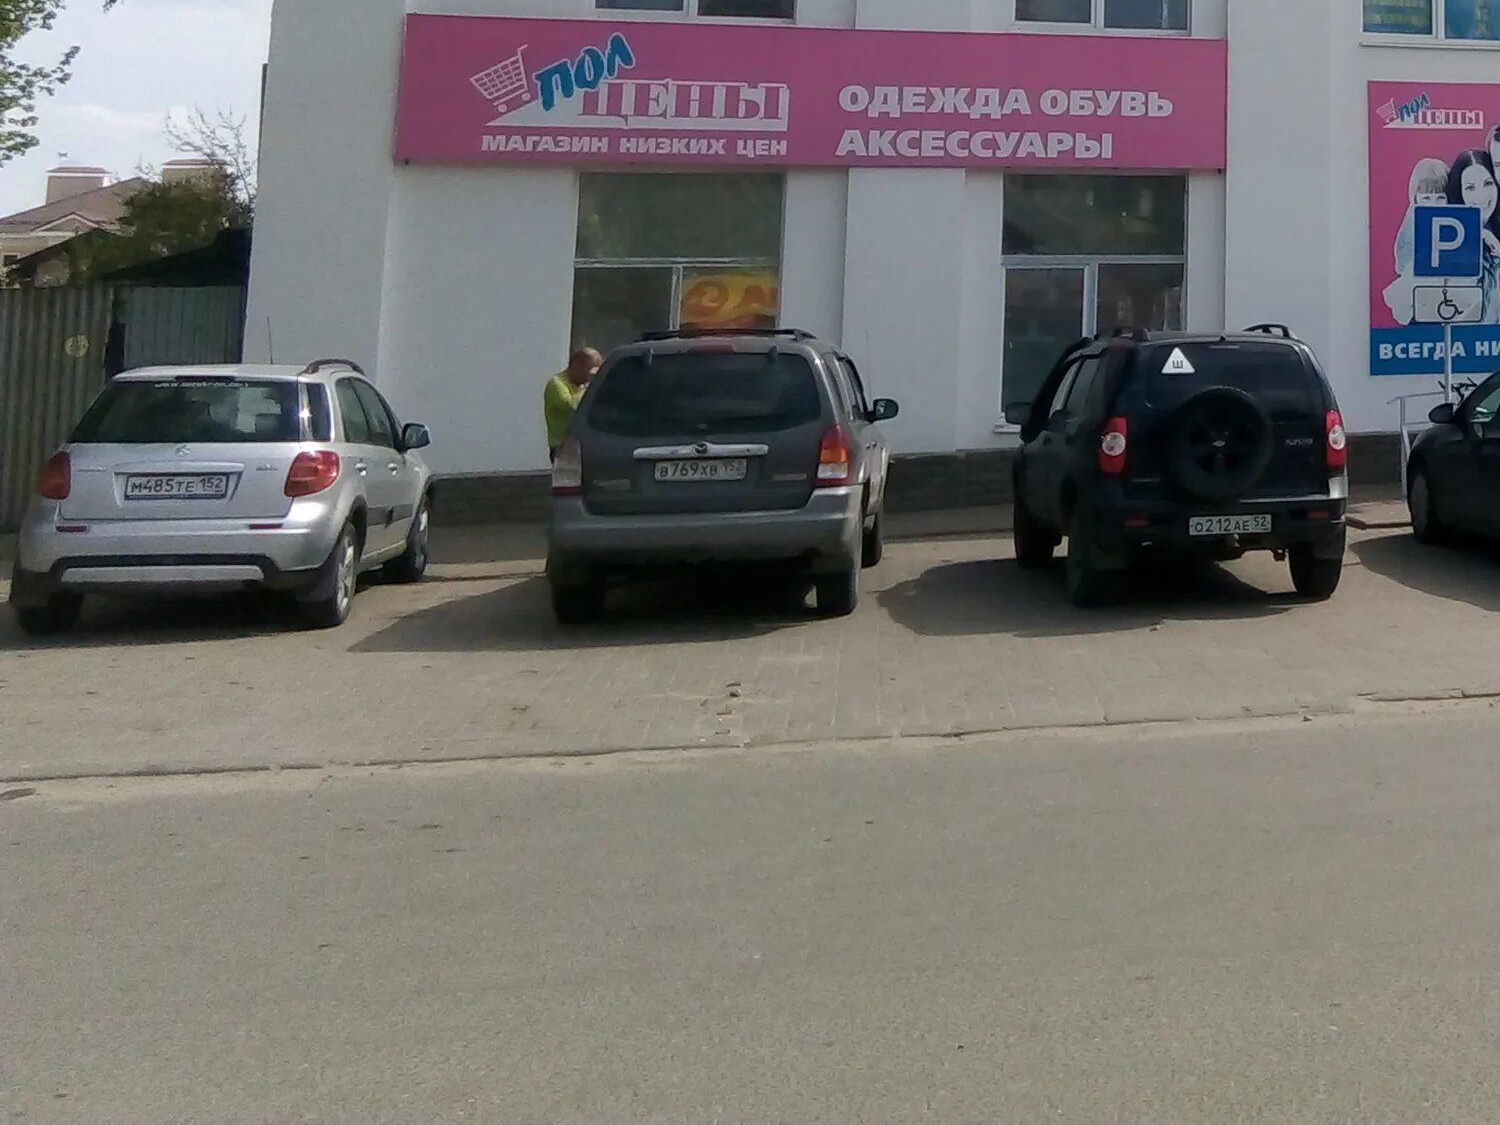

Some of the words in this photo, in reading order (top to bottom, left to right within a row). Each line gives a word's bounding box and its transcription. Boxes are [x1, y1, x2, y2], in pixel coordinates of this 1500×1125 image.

[532, 32, 636, 112] ПОЛ
[577, 78, 788, 128] ЦЕНЫ
[838, 85, 1032, 119] ОДЕЖДА
[1040, 89, 1174, 117] ОБУВЬ
[1397, 92, 1430, 123] ПОЛ
[1412, 109, 1483, 127] ЦЕНЫ
[481, 135, 609, 154] МАГАЗИН
[619, 137, 726, 155] НИЗКИХ
[736, 139, 788, 158] ЦЕН
[835, 129, 1113, 159] АКСЕССУАРЫ
[1430, 215, 1466, 269] P
[1172, 359, 1184, 369] Ш
[1378, 341, 1467, 361] ВСЕГДА
